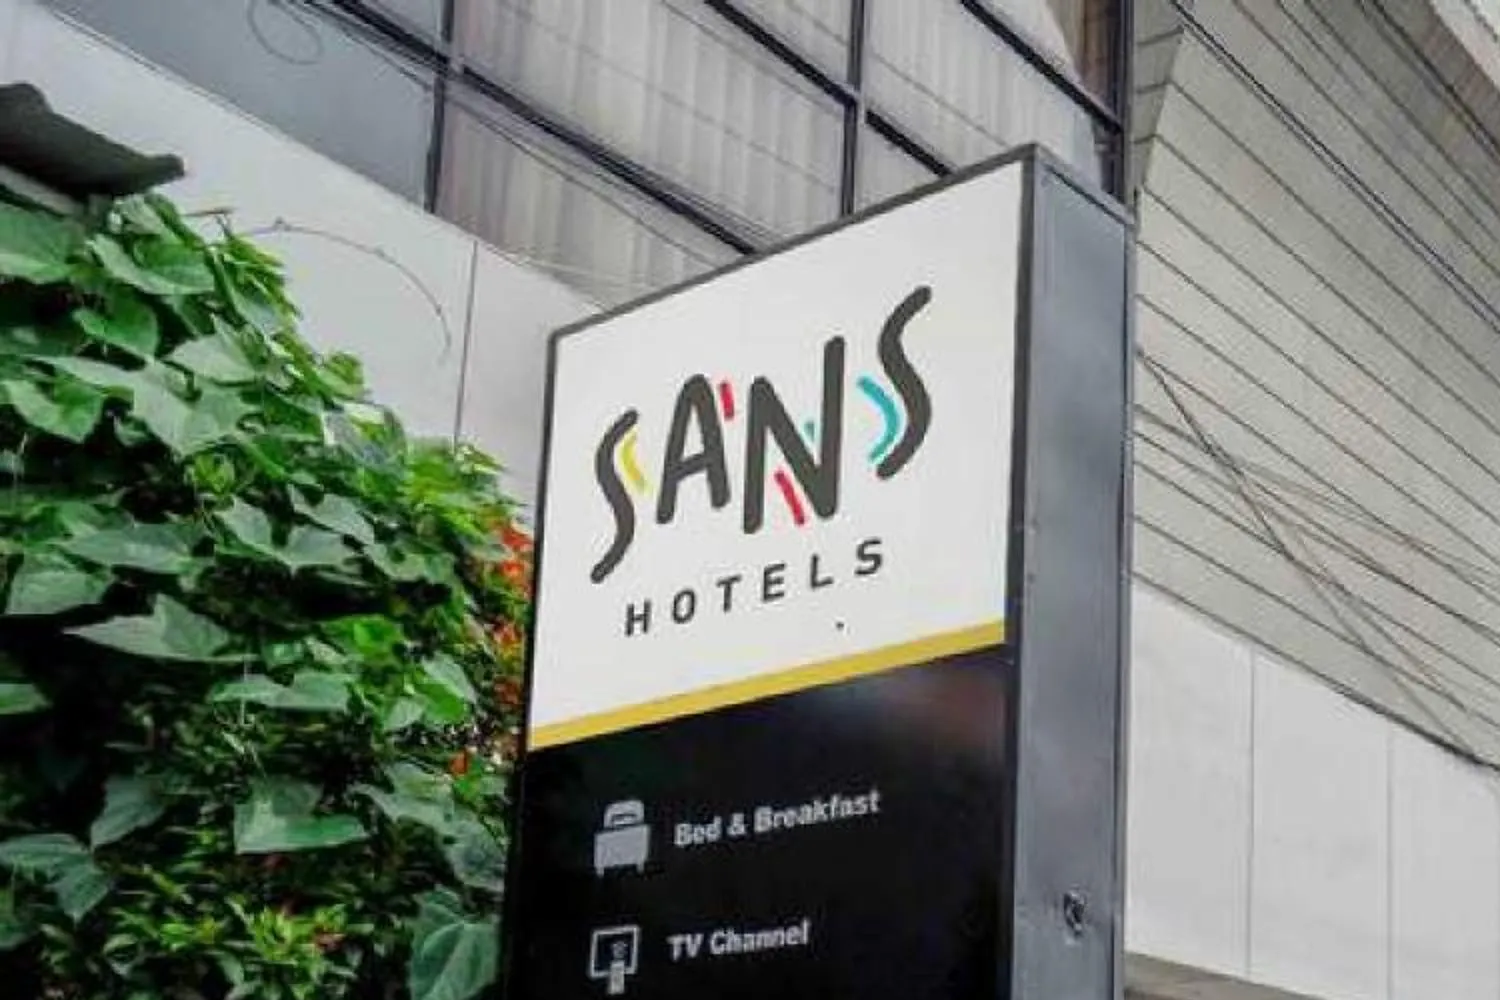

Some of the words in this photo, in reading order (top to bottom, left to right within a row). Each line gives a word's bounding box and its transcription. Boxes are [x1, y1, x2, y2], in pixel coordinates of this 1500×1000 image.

[590, 284, 932, 583] SANS
[625, 538, 884, 636] HOTELS
[674, 816, 722, 846] Bed
[728, 813, 747, 836] &
[753, 790, 880, 833] Breakfast
[667, 933, 703, 961] TV
[710, 918, 811, 955] Channel
